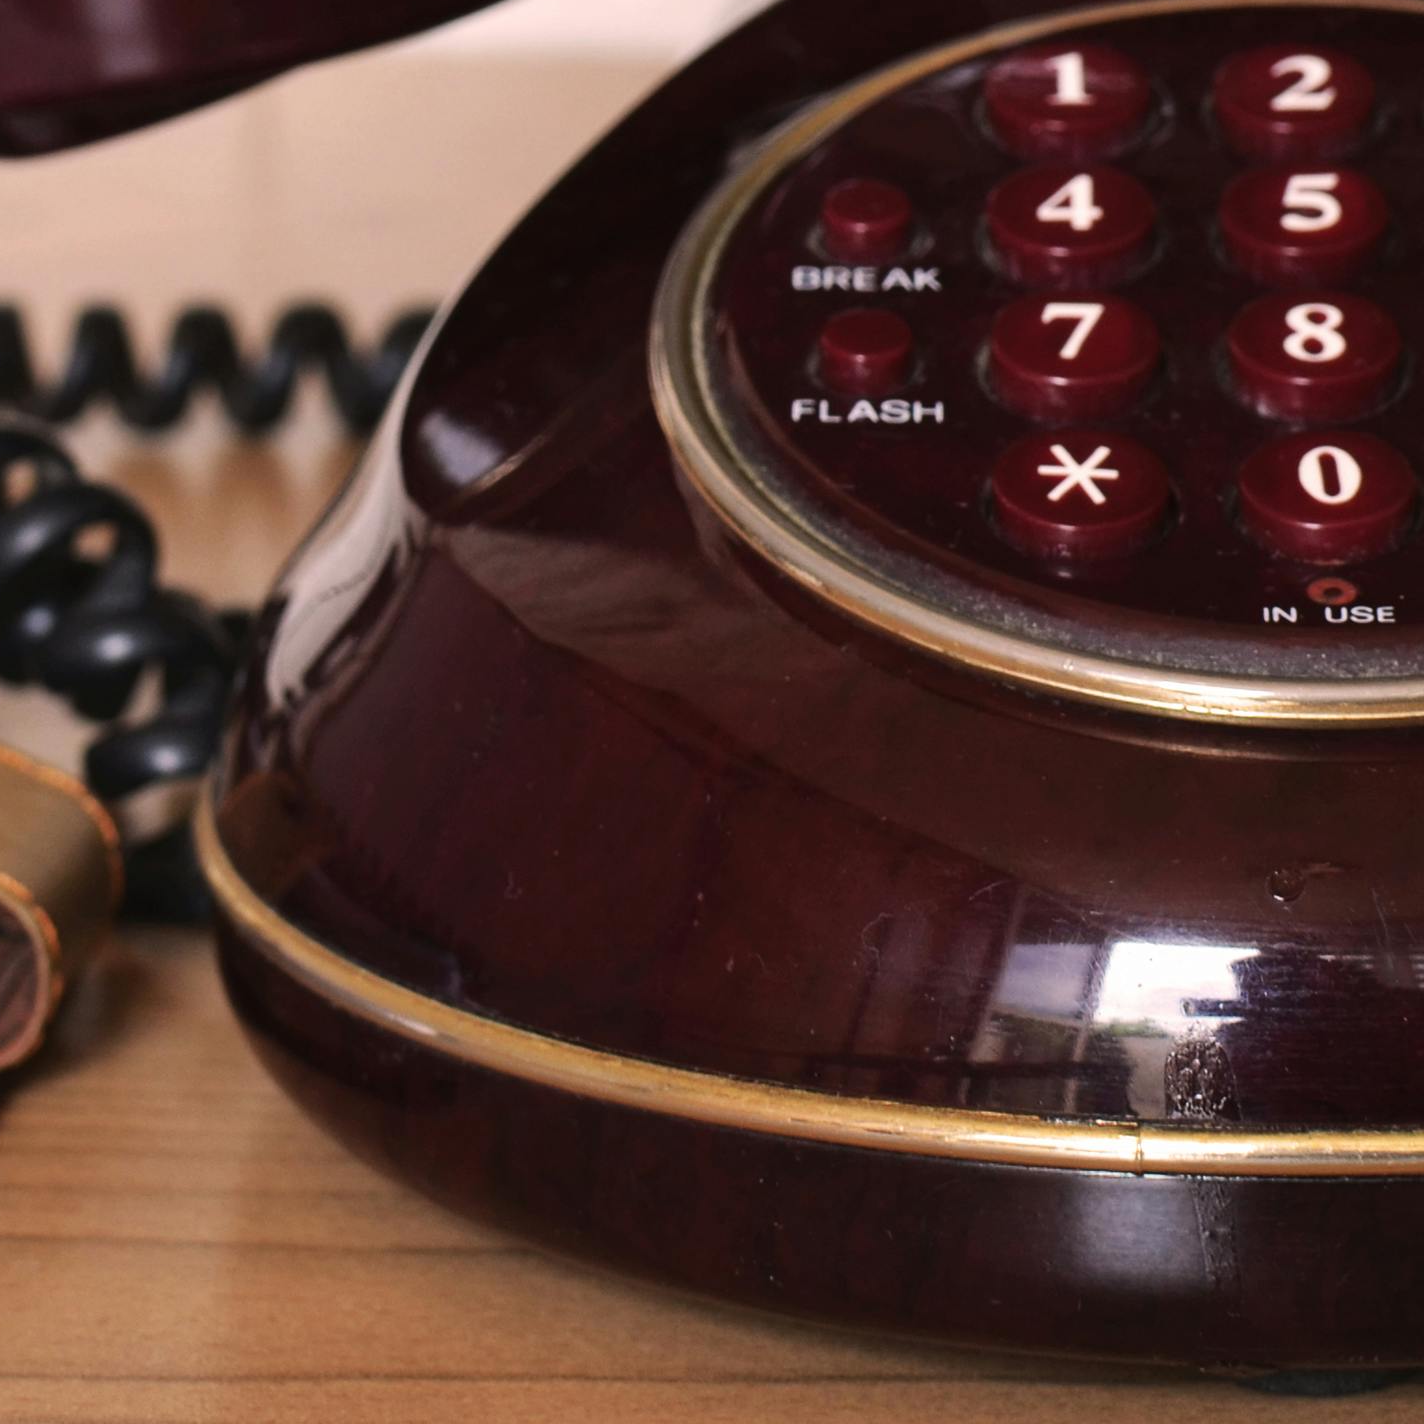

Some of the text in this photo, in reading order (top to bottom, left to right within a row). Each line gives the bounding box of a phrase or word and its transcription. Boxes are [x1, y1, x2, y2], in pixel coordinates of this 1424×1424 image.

[1050, 52, 1088, 105] 1
[1270, 55, 1335, 110] 2
[1036, 173, 1103, 231] 4
[1279, 172, 1343, 232] 5
[790, 264, 942, 292] BREAK
[1040, 302, 1104, 360] 7
[1282, 302, 1347, 363] 8
[790, 398, 945, 424] FLASH
[1297, 445, 1363, 505] 0
[1262, 605, 1396, 624] IN USE
